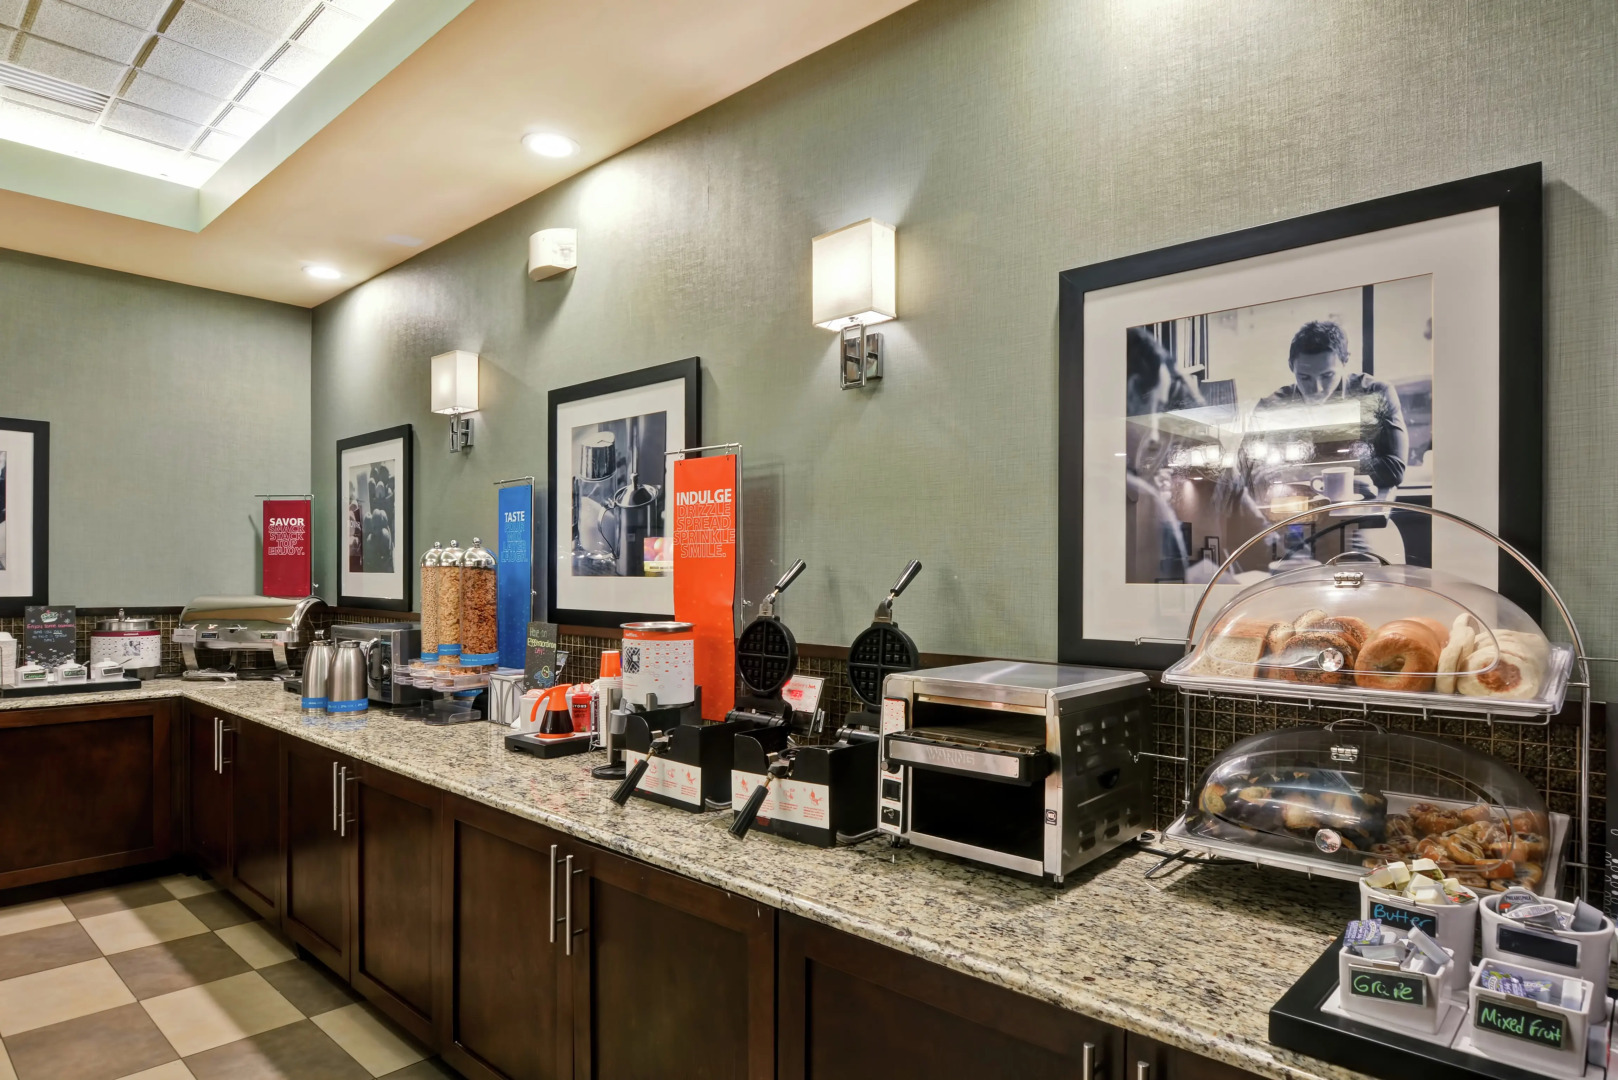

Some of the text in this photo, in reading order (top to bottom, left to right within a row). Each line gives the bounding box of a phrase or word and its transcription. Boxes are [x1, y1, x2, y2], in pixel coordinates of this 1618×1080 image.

[676, 488, 732, 506] INDULGE
[504, 510, 526, 523] TASTE
[677, 502, 731, 519] DRIZZLE
[269, 517, 305, 526] SAVOR
[676, 515, 731, 532] SPREAD
[269, 532, 304, 541] STACK
[276, 539, 298, 548] TOP
[673, 528, 735, 546] SPRINKLE
[268, 546, 306, 556] ENJOY.
[680, 543, 727, 559] SMILE.
[926, 746, 976, 767] WARING
[1505, 894, 1532, 902] PHILADELPHIA
[1373, 903, 1433, 928] Butter
[1481, 1007, 1563, 1042] Mixed Fruit
